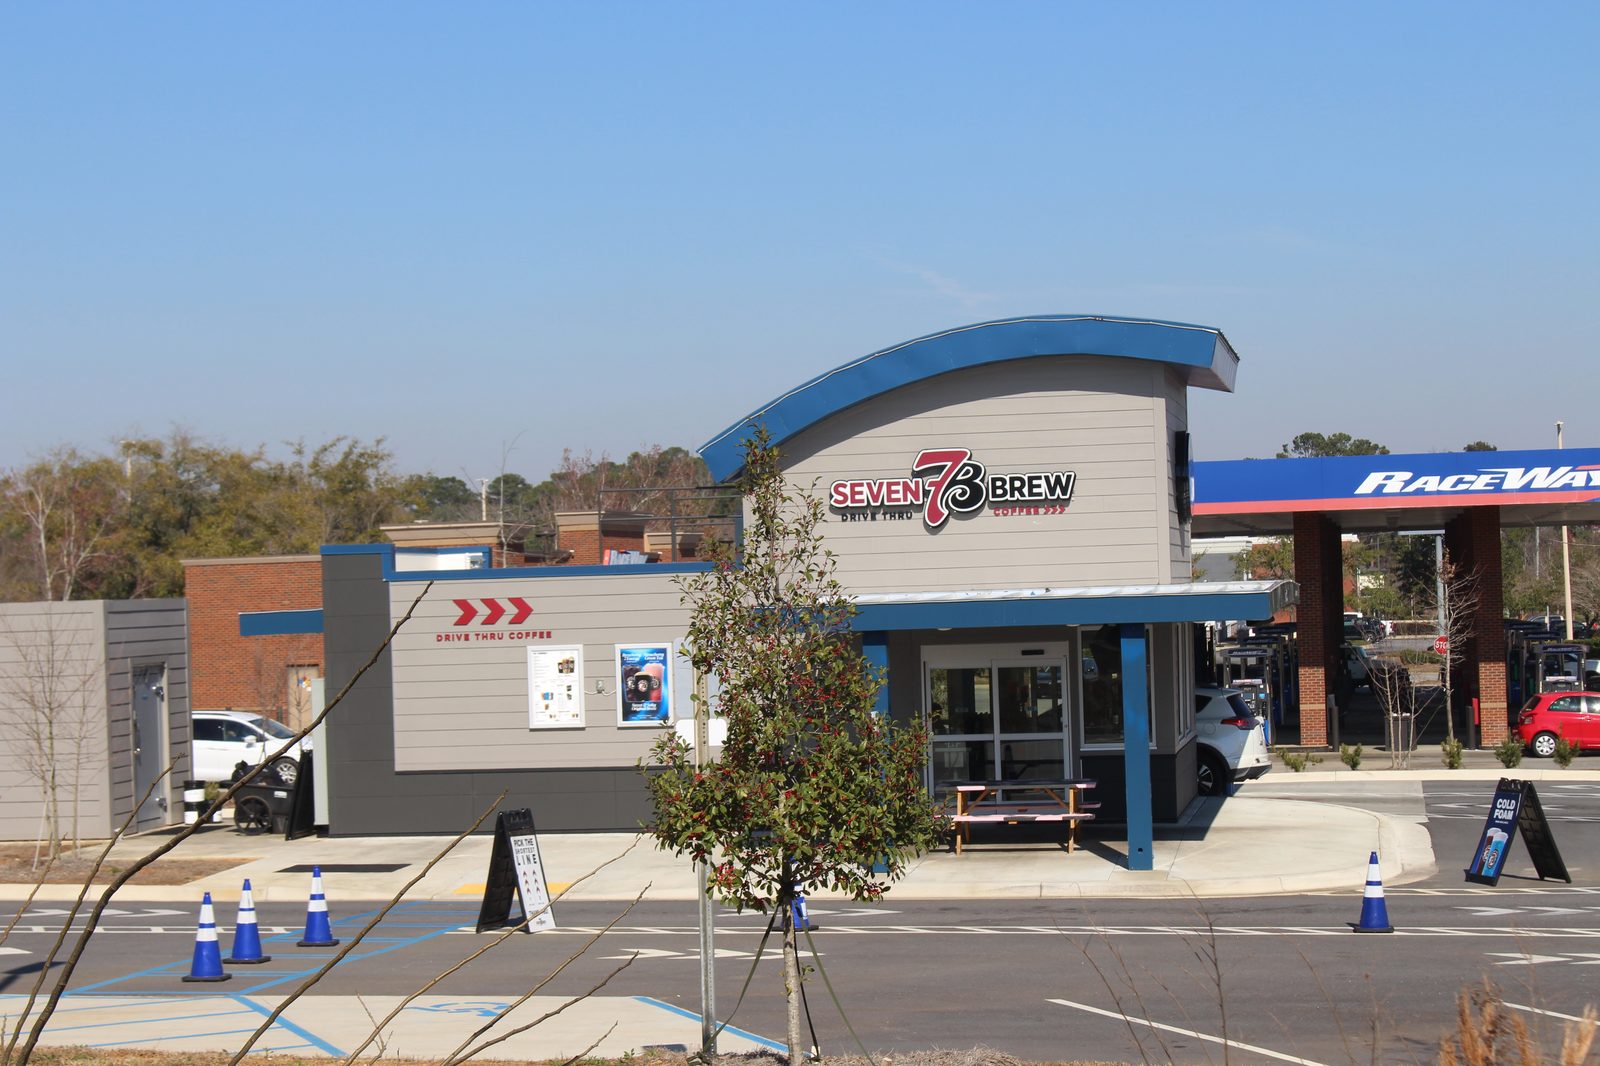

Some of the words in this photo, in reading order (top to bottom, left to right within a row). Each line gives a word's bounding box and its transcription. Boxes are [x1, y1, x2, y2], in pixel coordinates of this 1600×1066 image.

[831, 480, 922, 507] SEVEN
[989, 472, 1075, 501] BREW
[842, 511, 877, 522] DRIVE
[882, 510, 913, 522] THRU
[993, 506, 1040, 518] COFFEE
[436, 633, 470, 642] DRIVE
[475, 632, 504, 641] THRU
[508, 631, 552, 640] COFFEE
[1497, 799, 1516, 809] COLD
[1493, 809, 1514, 819] FOAM
[524, 838, 534, 846] THE
[516, 854, 537, 866] LINE
